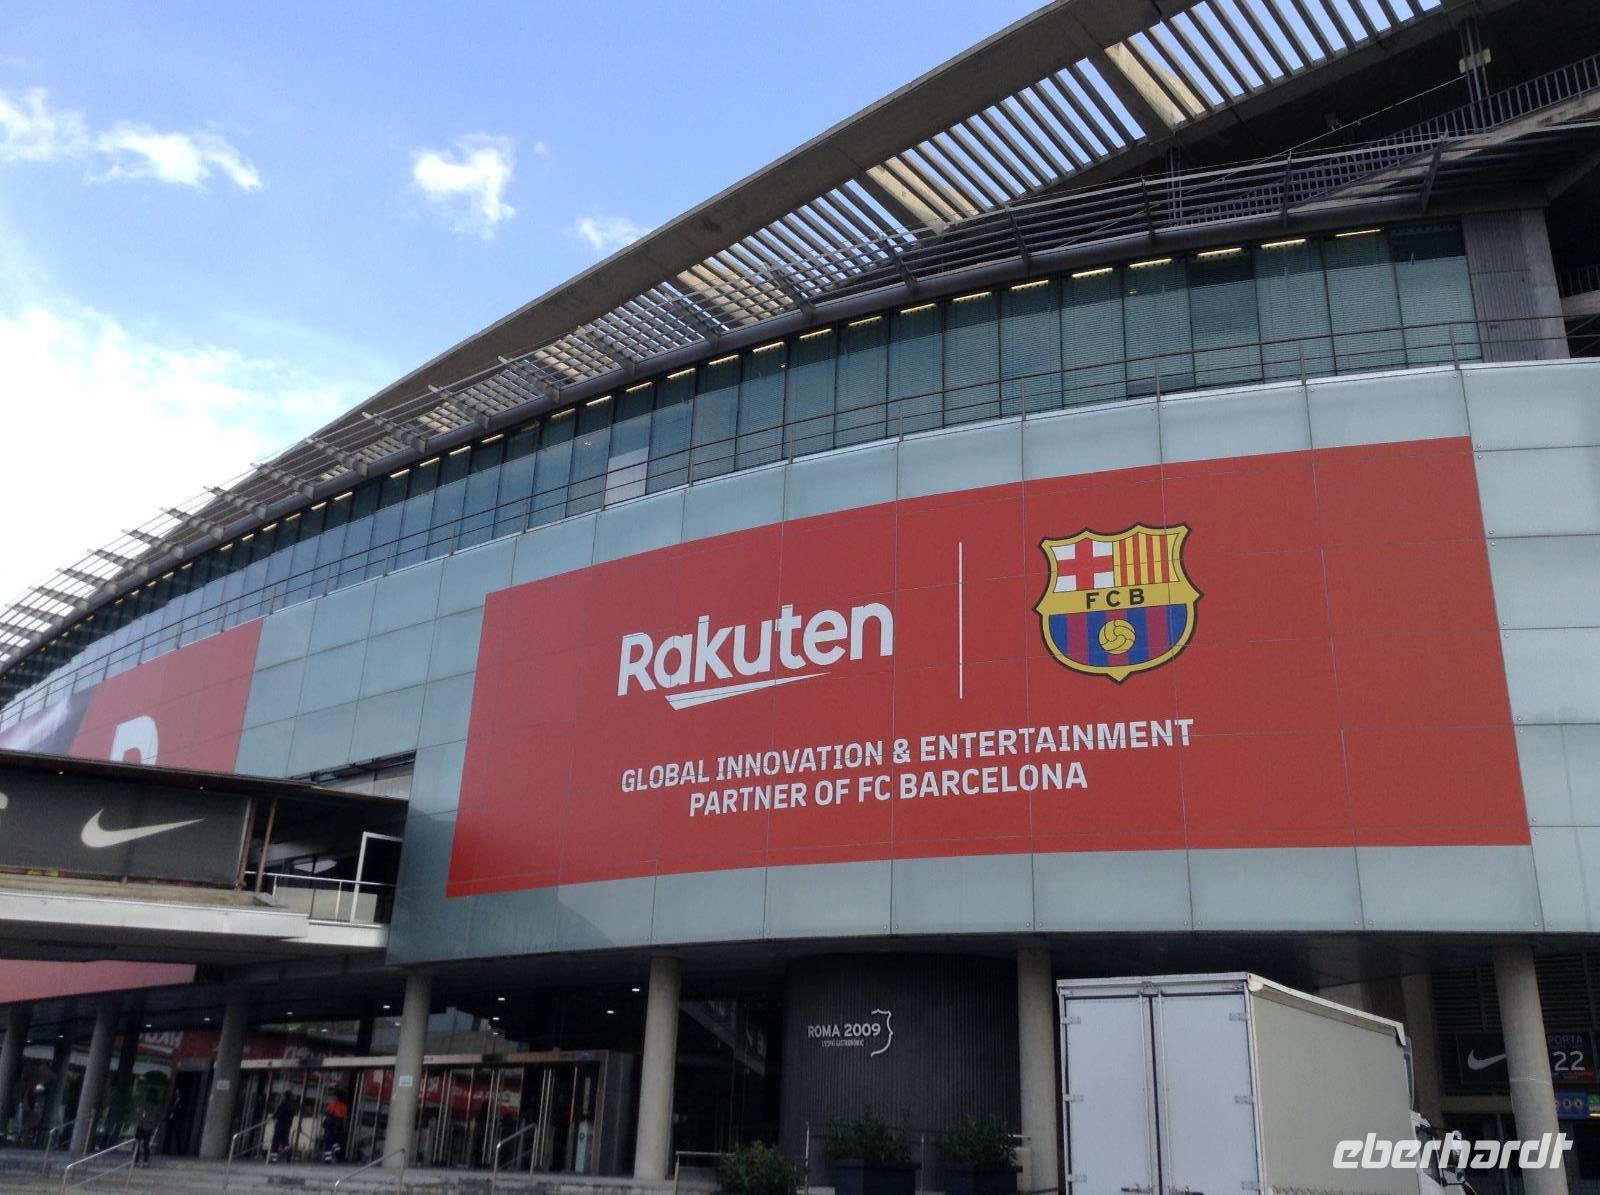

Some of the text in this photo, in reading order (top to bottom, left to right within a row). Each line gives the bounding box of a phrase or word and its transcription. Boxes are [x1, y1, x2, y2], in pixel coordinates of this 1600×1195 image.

[1086, 588, 1145, 610] FCB
[617, 602, 895, 697] Rakuten
[621, 717, 1195, 794] GLOBAL INNOVATION & ENTERTAINMENT
[689, 761, 1089, 818] PARTNER OF FC BARCELONA
[807, 1023, 881, 1039] ROMA 2009
[1552, 1050, 1586, 1071] 22
